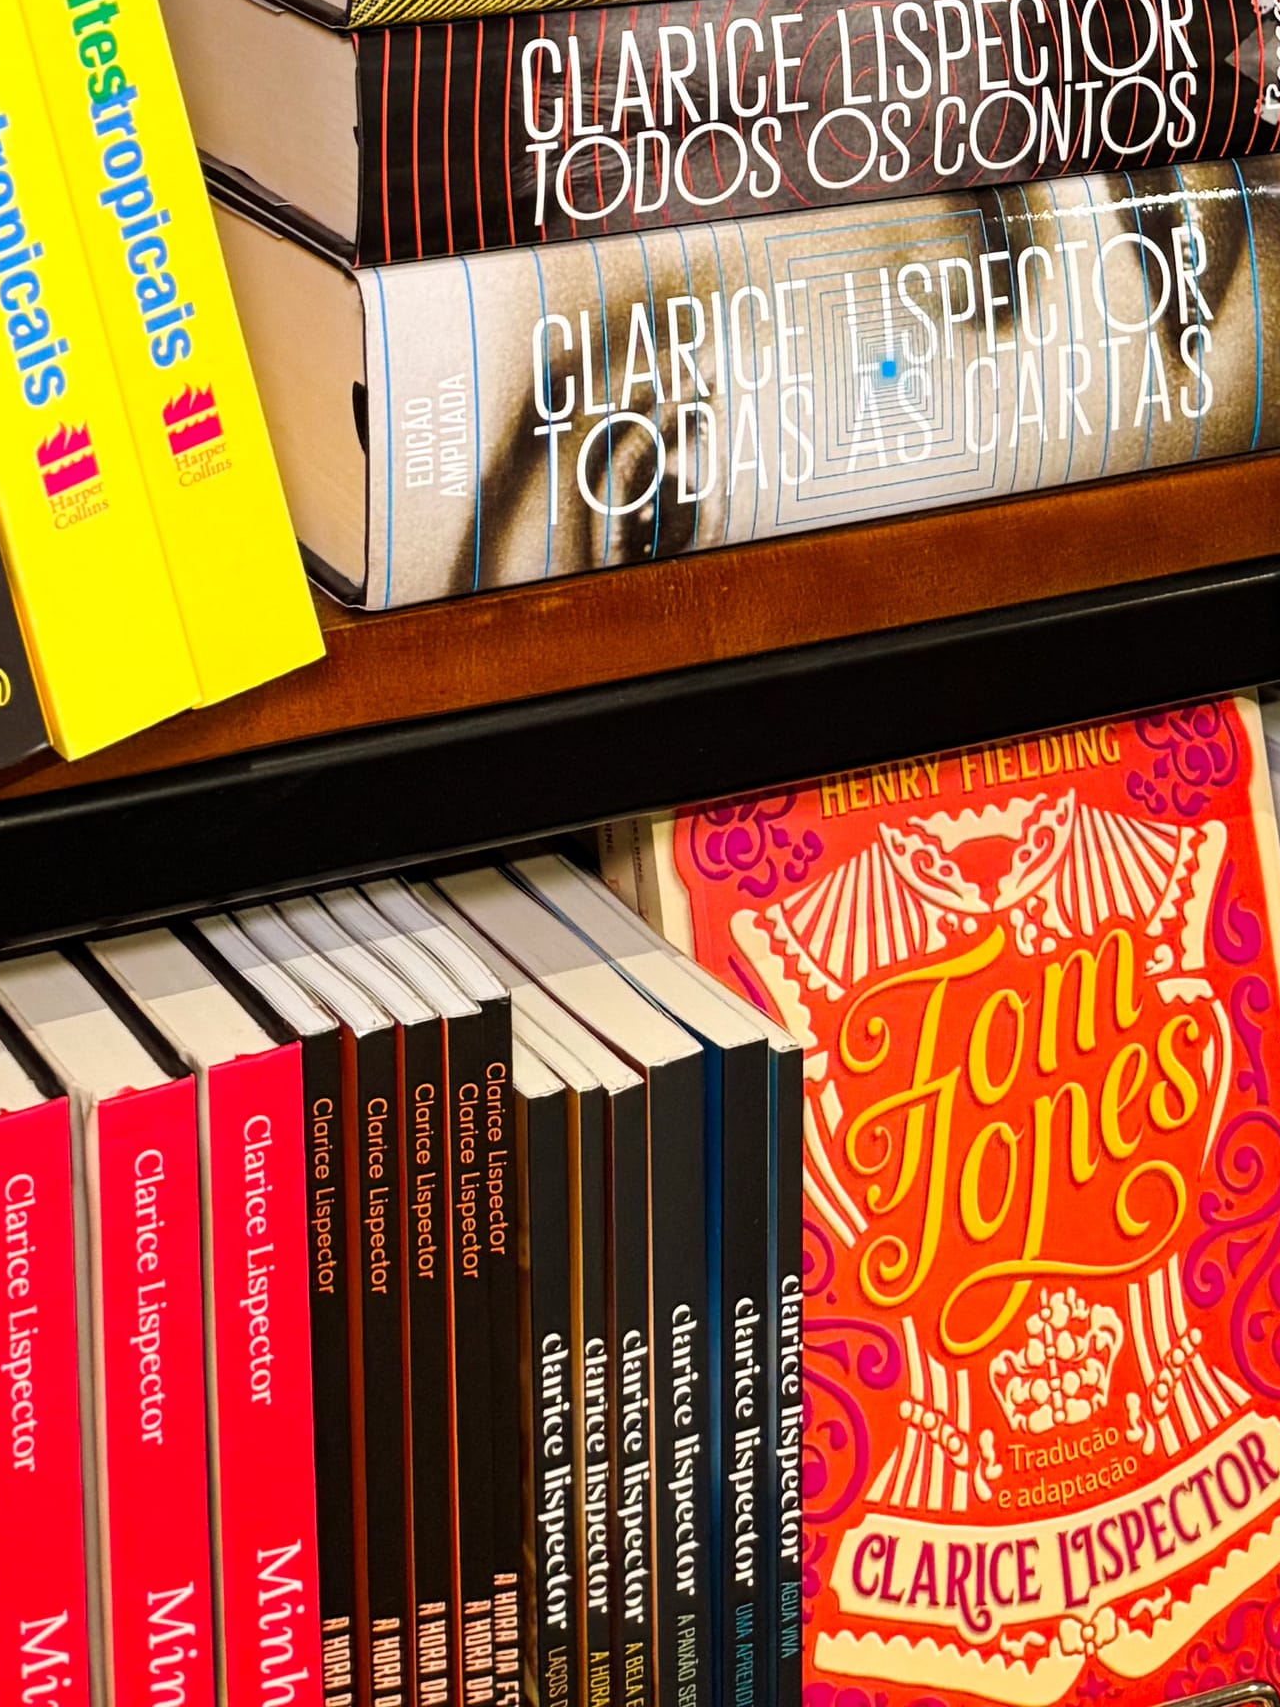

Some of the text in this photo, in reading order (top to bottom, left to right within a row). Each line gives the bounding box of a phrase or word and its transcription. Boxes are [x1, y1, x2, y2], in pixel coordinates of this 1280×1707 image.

[520, 11, 811, 141] CLARICE
[523, 70, 1199, 227] TODOS OS CONTOS
[531, 225, 1212, 424] CLARICE LISPECTOR
[404, 394, 436, 491] EDIÇÃO
[438, 371, 469, 500] AMPLIADA
[533, 323, 1216, 528] TODAS AS CARTAS
[820, 723, 1121, 822] HENRY FIELDING
[839, 924, 1143, 1105] Tom
[414, 1083, 436, 1278] Clarice Lispector
[845, 1014, 1200, 1356] Jones
[0, 1173, 38, 1471] Clarice Lispector
[670, 1304, 699, 1595] clarice lispector
[852, 1430, 1280, 1632] CLARICE LISPECTOR
[998, 1455, 1138, 1509] e adaptação
[1009, 1425, 1120, 1474] Tradução
